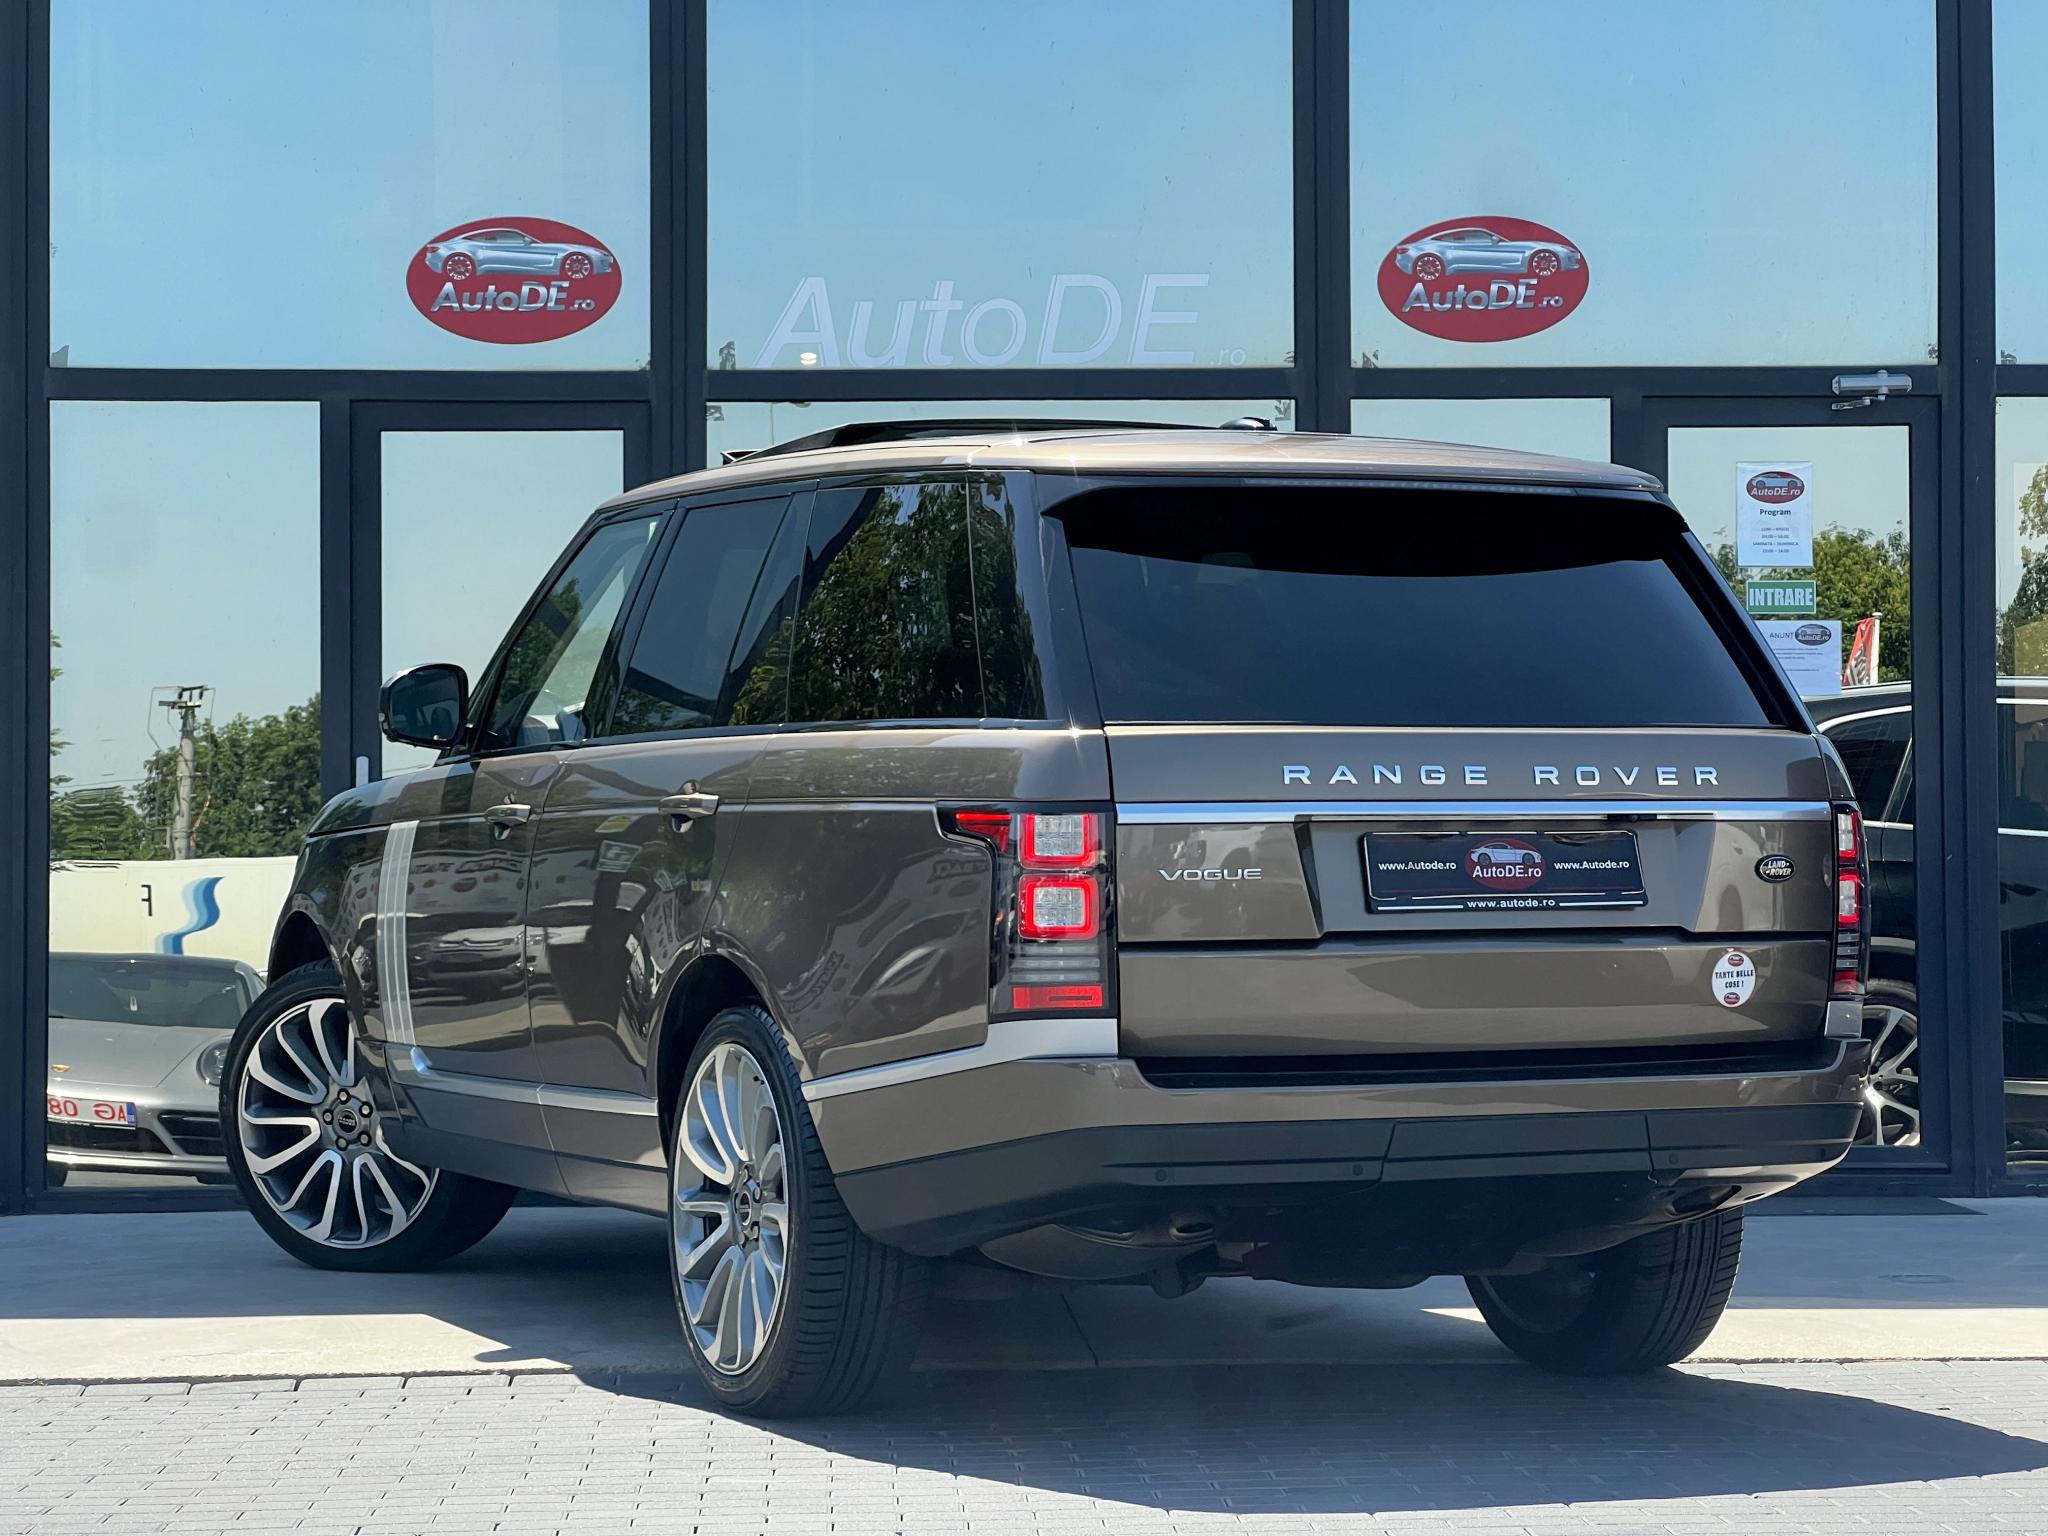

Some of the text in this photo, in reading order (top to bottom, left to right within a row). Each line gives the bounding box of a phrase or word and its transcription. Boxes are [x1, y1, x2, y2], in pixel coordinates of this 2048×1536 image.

[1759, 508, 1792, 518] Program
[1749, 588, 1814, 607] INTRARE
[1283, 764, 1719, 786] RANGE ROVER
[1377, 860, 1457, 871] www.Autode.ro
[1553, 859, 1630, 870] www.Autode.ro
[1767, 860, 1786, 868] LAND
[1159, 868, 1262, 881] VOGUE
[1472, 864, 1543, 879] AutoDE.ro
[1769, 868, 1792, 876] ROVER
[1467, 897, 1556, 909] www.autode.ro
